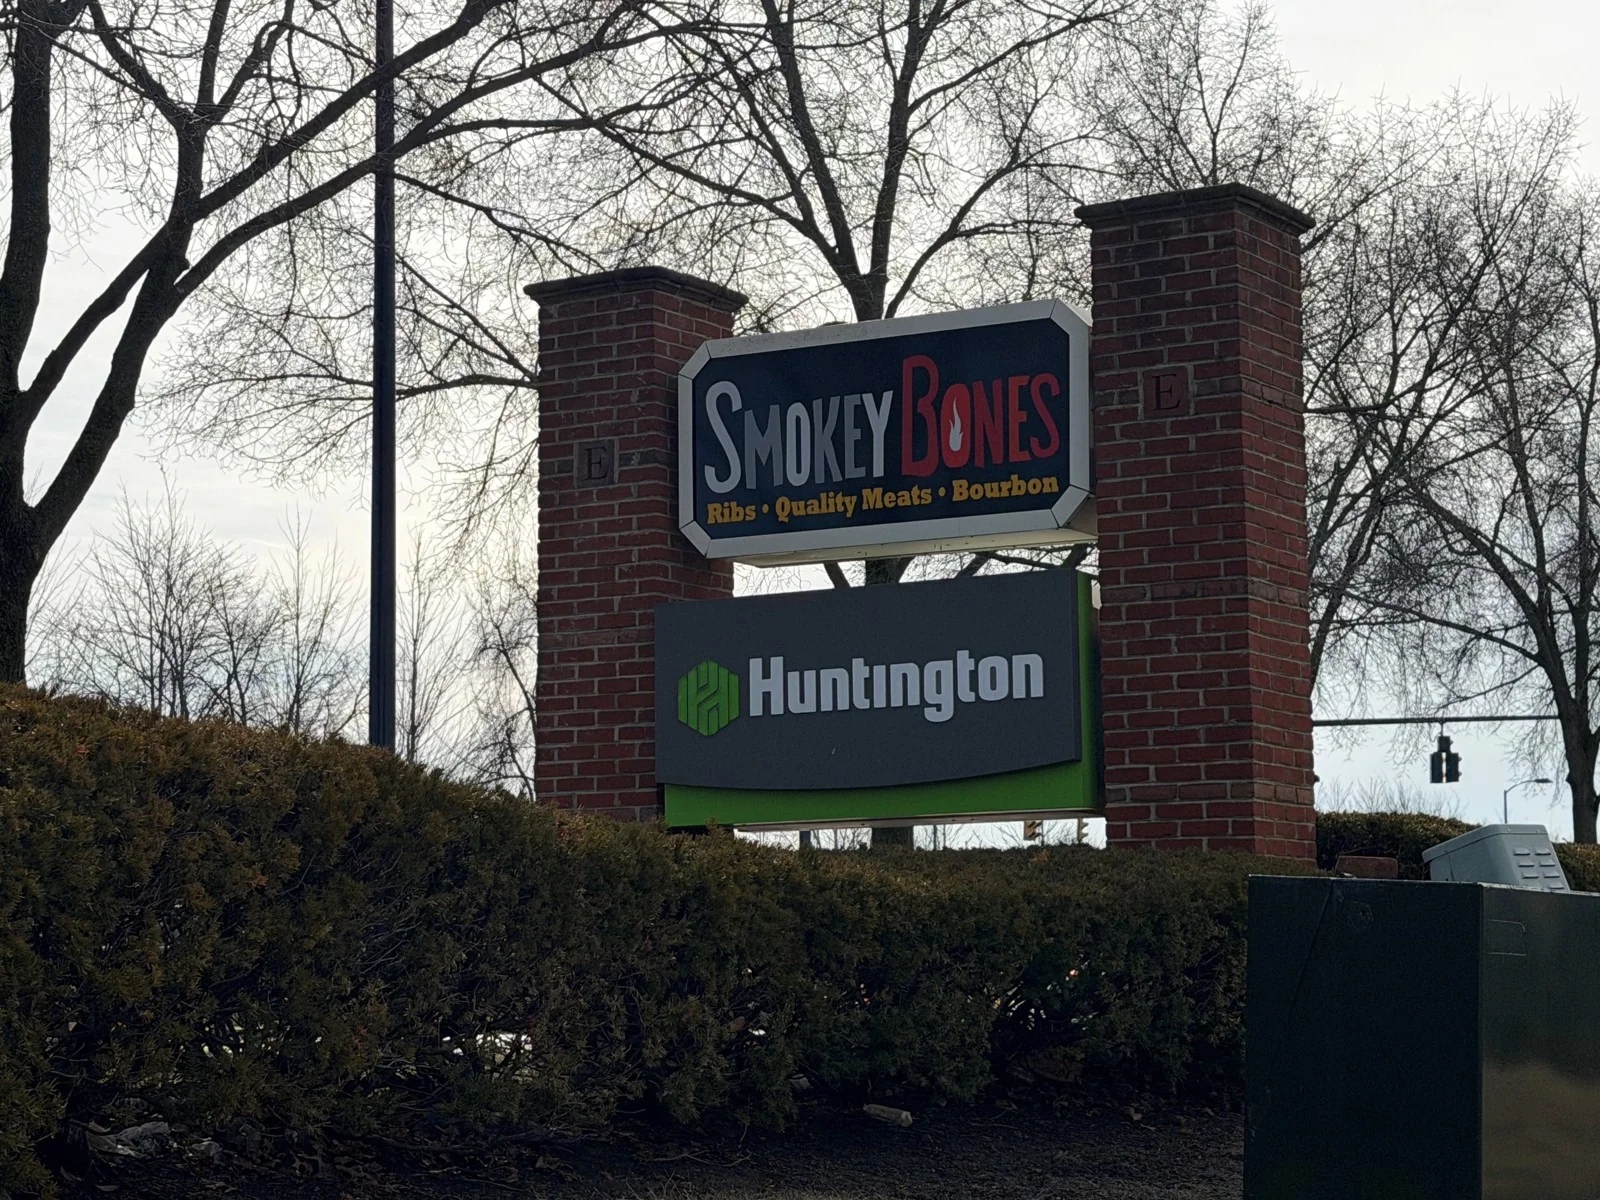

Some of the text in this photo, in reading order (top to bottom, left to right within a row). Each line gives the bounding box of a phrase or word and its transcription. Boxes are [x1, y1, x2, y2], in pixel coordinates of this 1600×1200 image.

[1151, 373, 1181, 411] E
[704, 355, 1061, 494] SMOKEY BONES
[583, 446, 609, 481] E
[707, 474, 1059, 524] Ribs Quality Meats Bourbon
[748, 649, 1044, 723] Huntington
